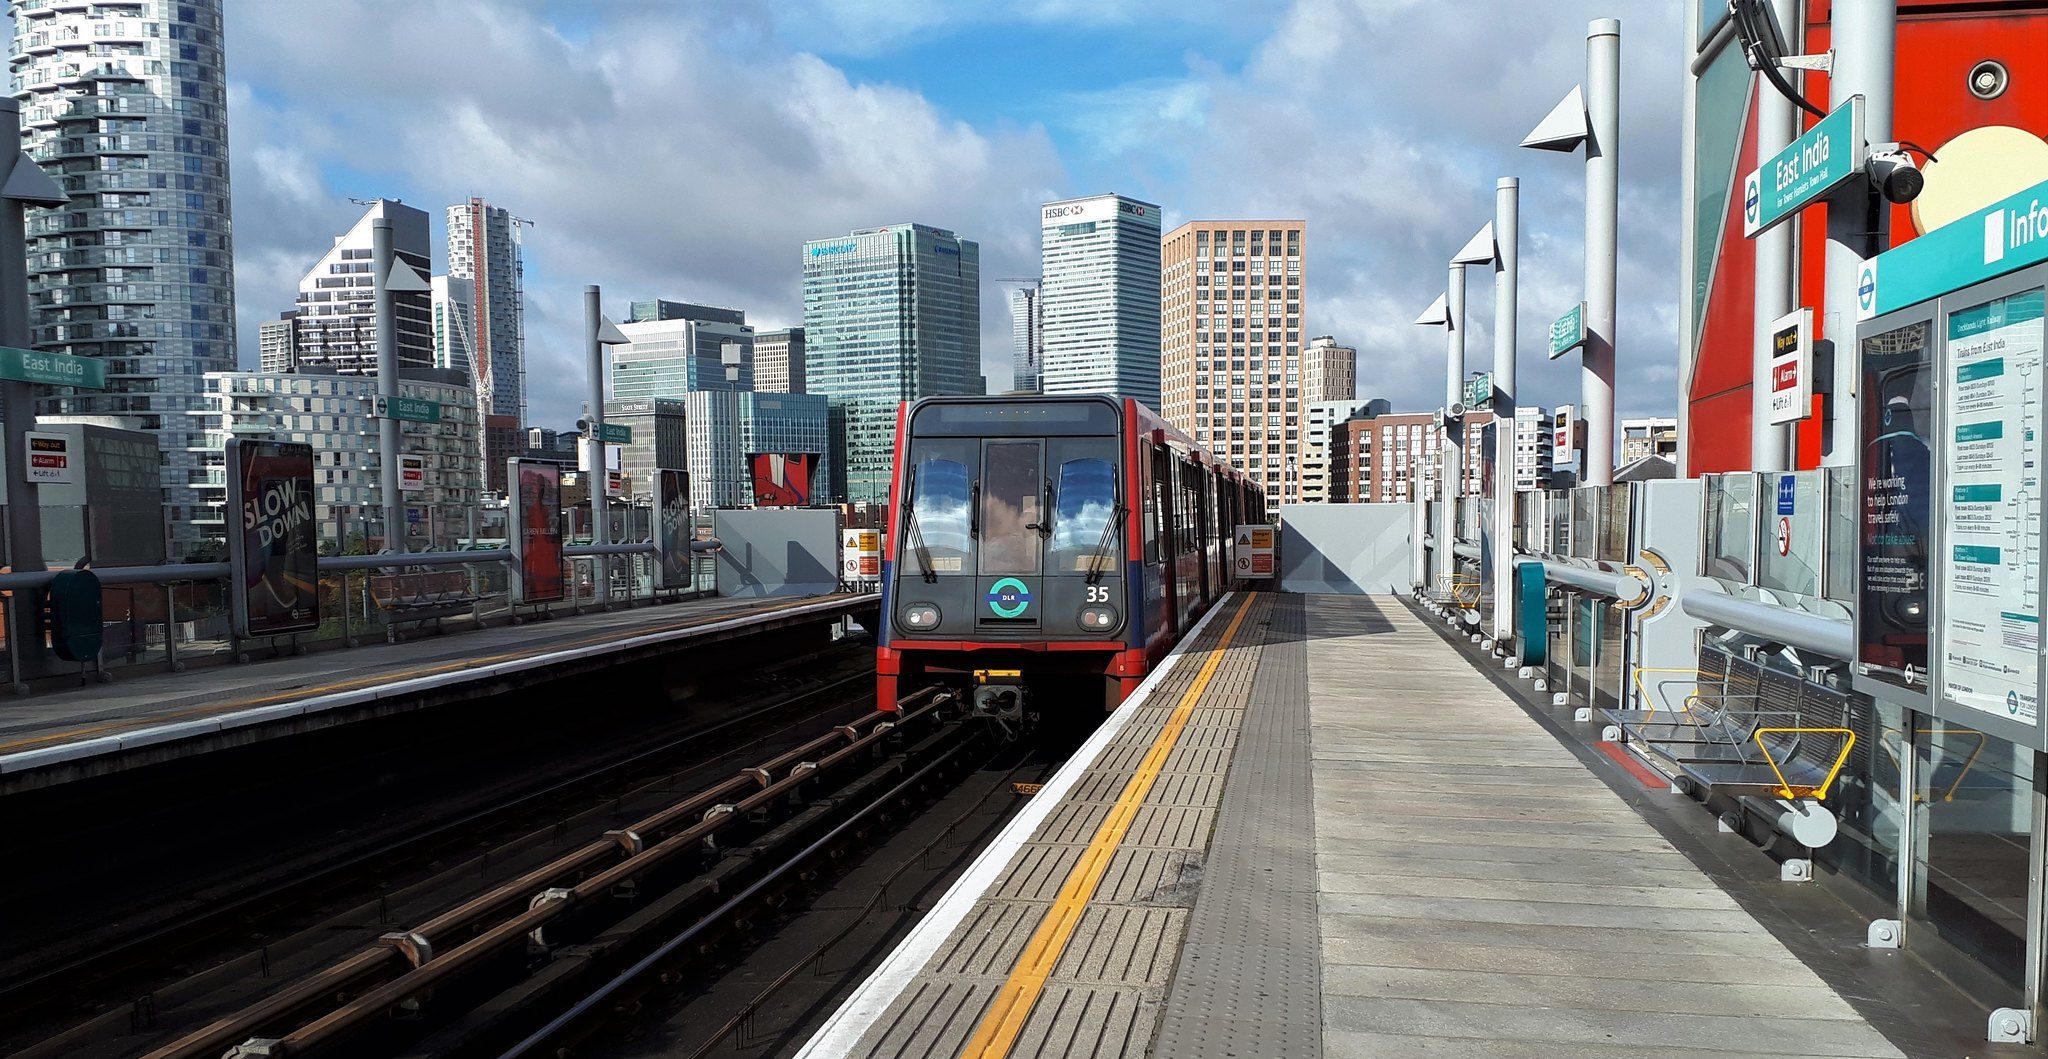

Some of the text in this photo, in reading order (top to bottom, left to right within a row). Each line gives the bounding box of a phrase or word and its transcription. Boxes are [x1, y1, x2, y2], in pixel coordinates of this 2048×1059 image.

[1776, 131, 1829, 192] East India
[1782, 191, 1793, 204] Tower
[1793, 181, 1809, 198] Hamlets
[1809, 175, 1819, 188] Town
[1819, 167, 1828, 181] Hall
[1045, 207, 1070, 219] HSBC
[1119, 201, 1136, 213] HSBC
[2010, 199, 2048, 250] Info
[1776, 334, 1793, 351] Way out
[1957, 337, 2006, 359] Trains from East India
[22, 354, 84, 375] East India
[1780, 369, 1793, 383] Alarm
[398, 401, 430, 414] East India
[38, 440, 49, 449] Way
[38, 456, 55, 464] Alarm
[1867, 475, 1906, 490] We're working
[244, 476, 297, 530] SLOW
[662, 492, 683, 524] SLOW
[1867, 492, 1909, 508] to help London
[256, 501, 311, 549] DOWN
[667, 509, 688, 535] DOWN
[1867, 511, 1883, 524] travel
[539, 527, 558, 535] MILLEN
[1086, 586, 1109, 603] 35
